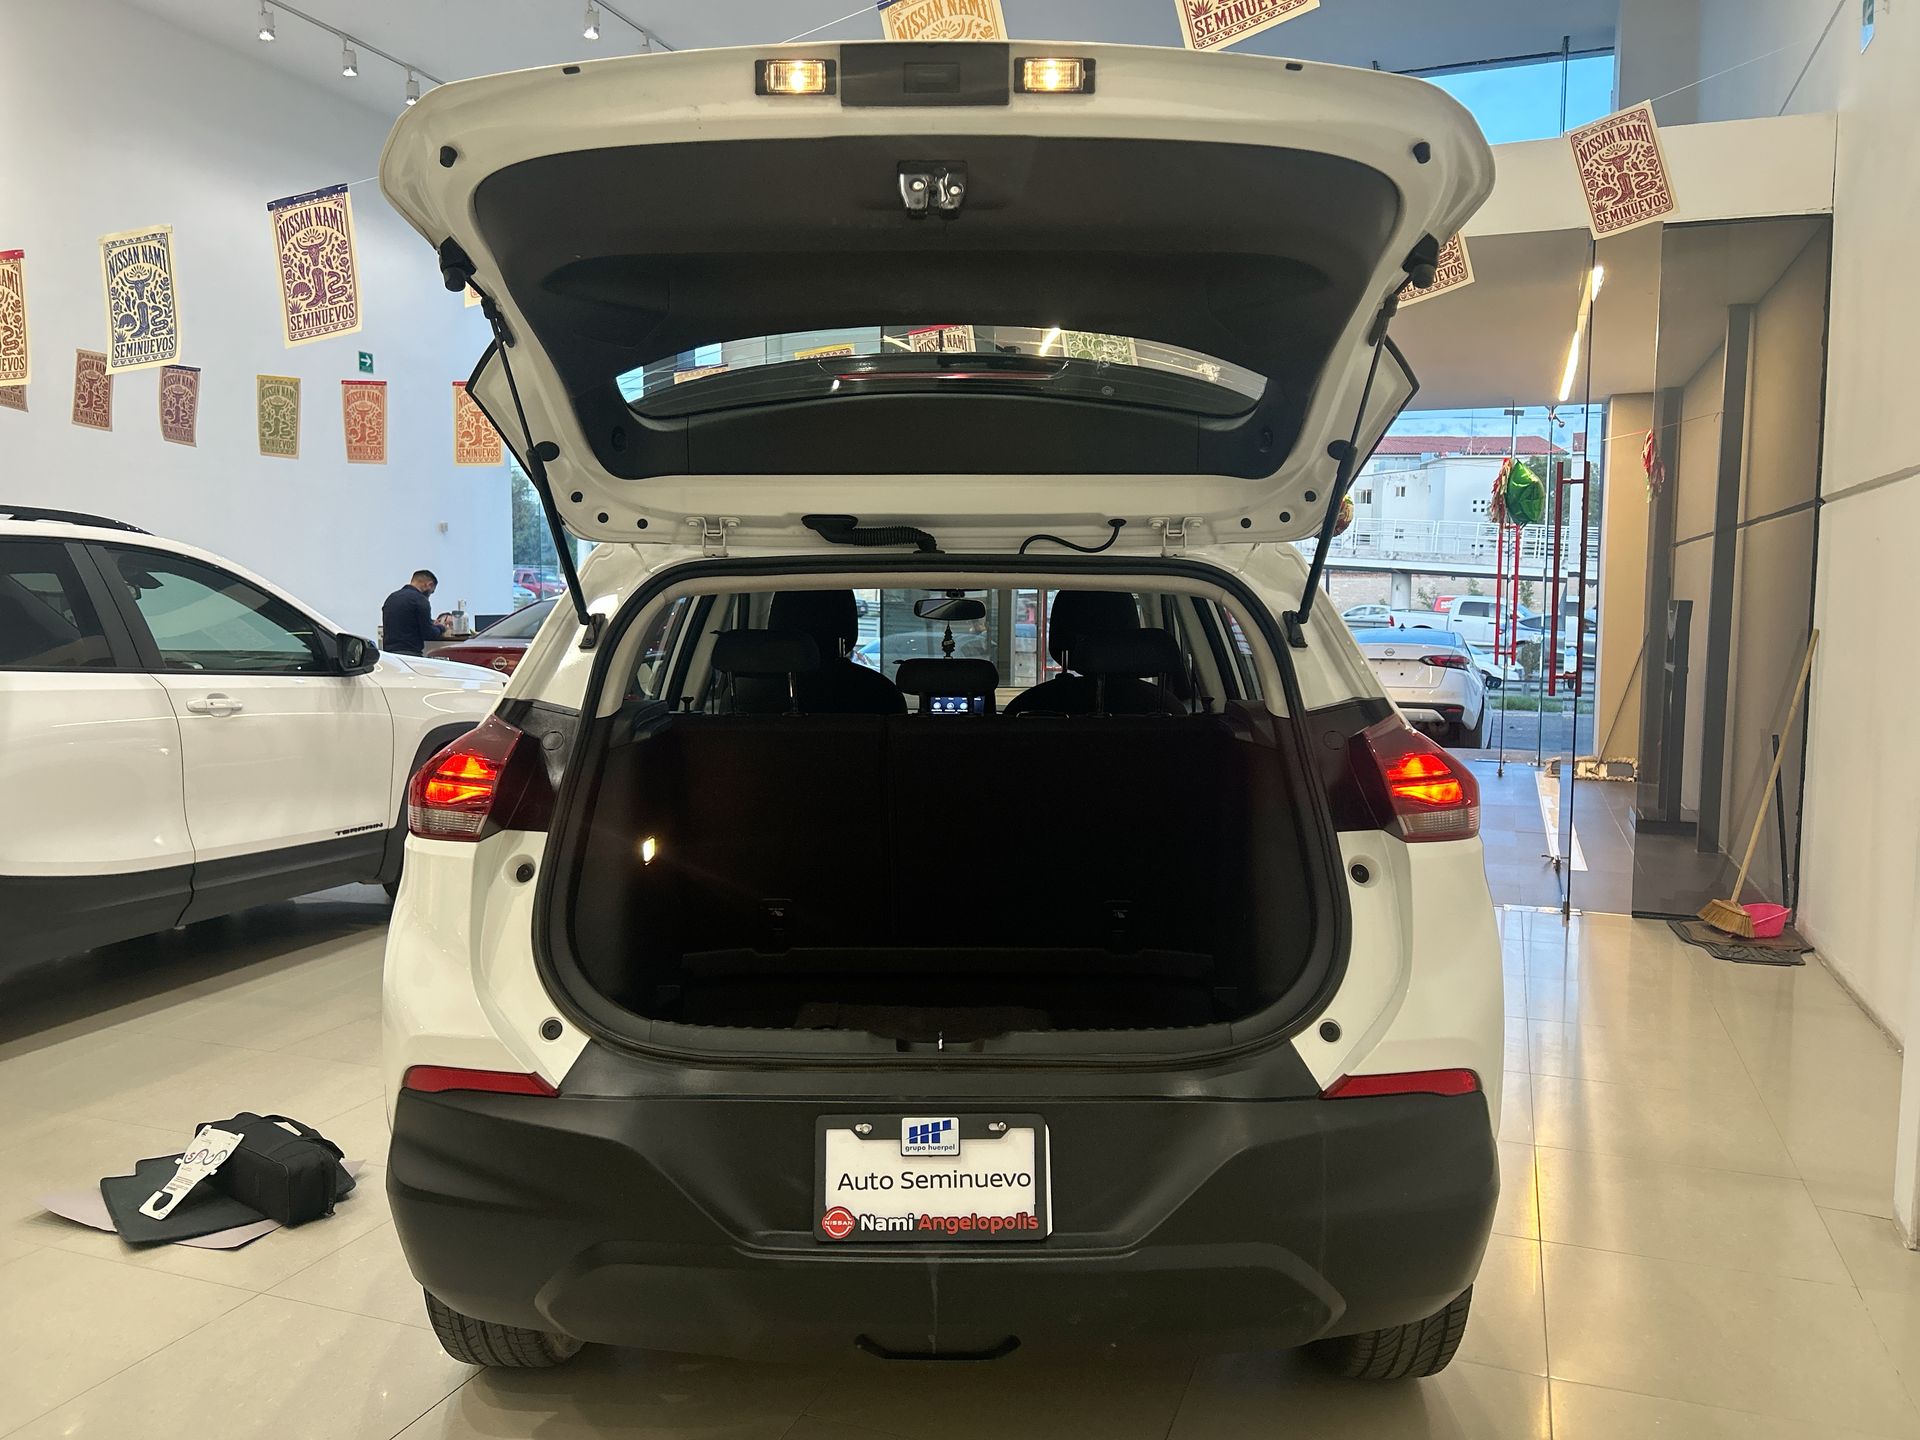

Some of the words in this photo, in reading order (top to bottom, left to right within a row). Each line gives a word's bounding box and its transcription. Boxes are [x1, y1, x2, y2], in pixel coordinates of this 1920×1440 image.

[896, 0, 945, 40] NISSAN
[948, 0, 990, 22] NAMI
[1578, 129, 1617, 168] NISSAN
[1616, 124, 1652, 144] NAMI
[1596, 191, 1669, 226] SEMINUEVOS
[278, 208, 314, 252] NISSAN
[314, 206, 346, 237] NAMI
[108, 245, 141, 286] NISSAN
[141, 244, 168, 275] NAMI
[0, 268, 20, 298] AMI
[290, 302, 355, 332] SEMINUEVOS
[114, 336, 174, 359] SEMINUEVOS
[918, 337, 945, 352] NISSA
[946, 334, 967, 352] NAMI
[0, 356, 25, 373] EVOS
[457, 448, 499, 458] SEMINUEVOS
[335, 822, 383, 836] TERRAIN
[905, 1144, 926, 1152] grupo
[928, 1143, 956, 1152] huerpel
[837, 1172, 894, 1191] Auto
[901, 1170, 1031, 1189] Seminuevo
[860, 1213, 915, 1232] Nami
[917, 1212, 1039, 1234] Angelopolis
